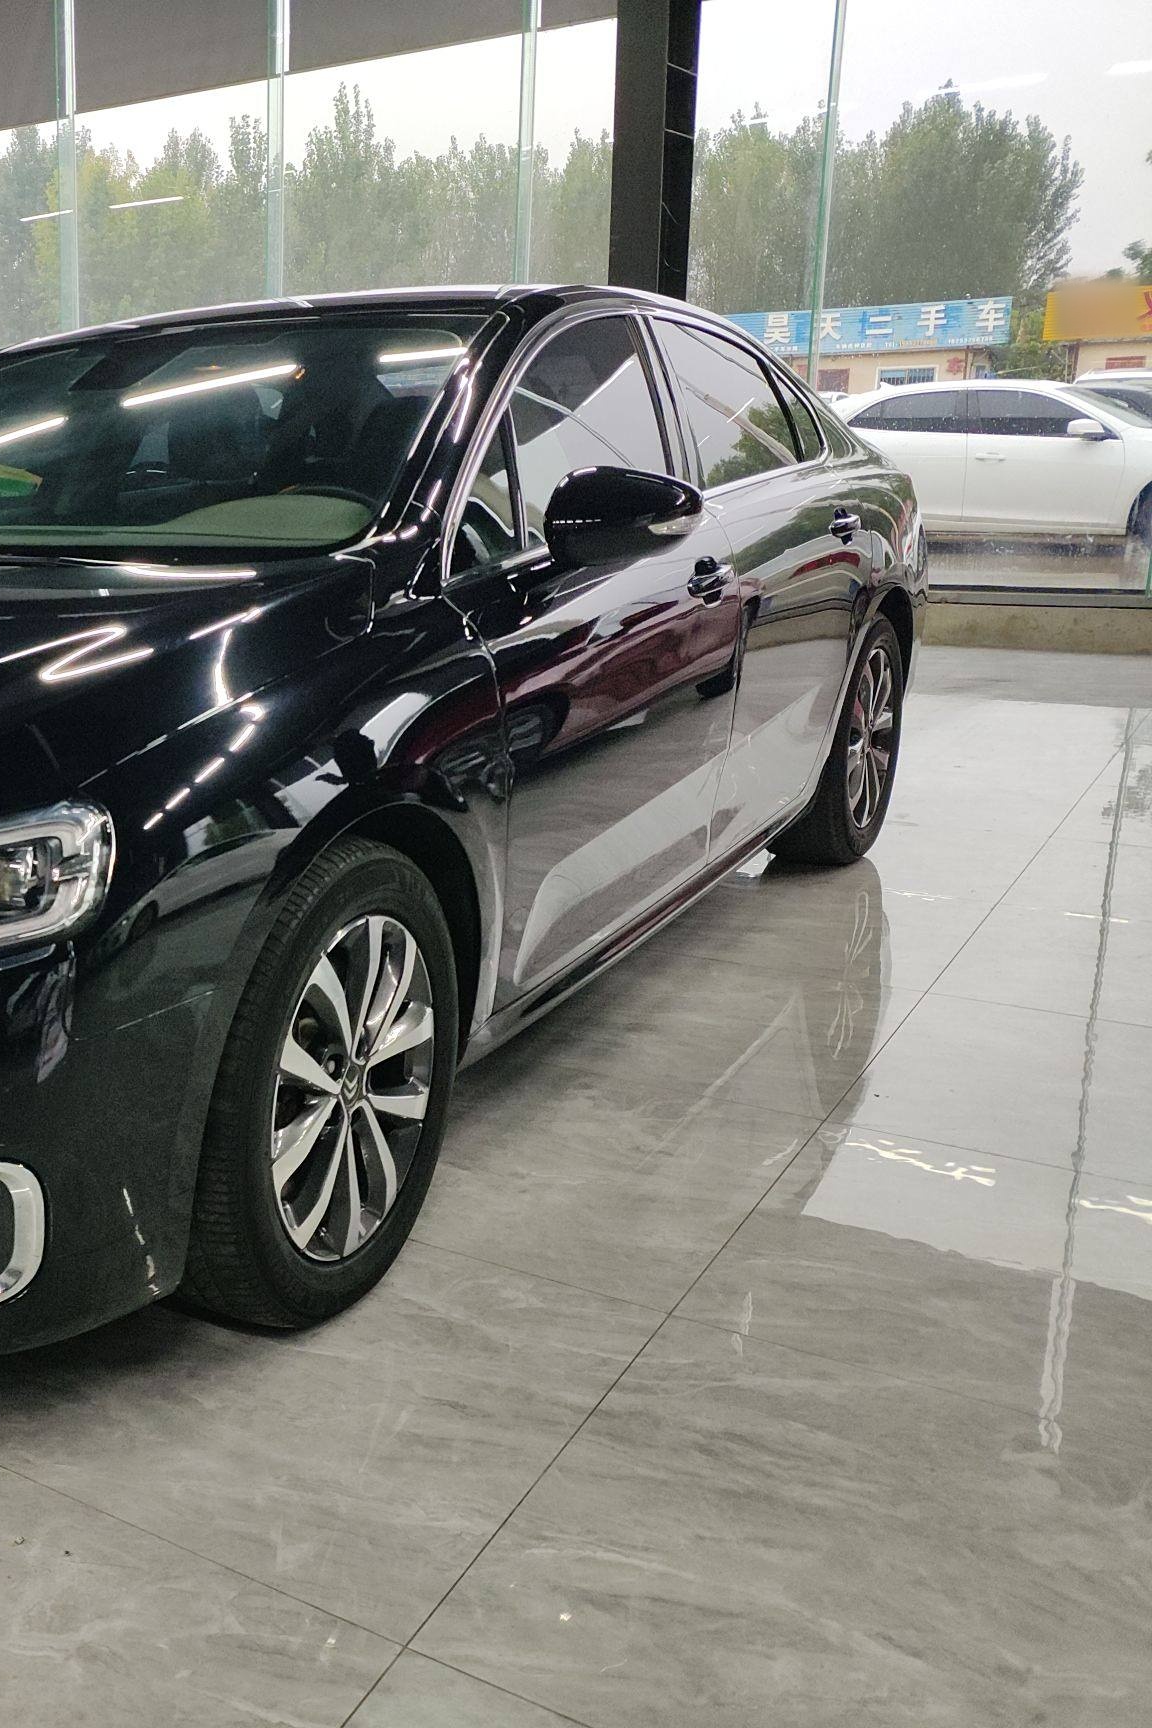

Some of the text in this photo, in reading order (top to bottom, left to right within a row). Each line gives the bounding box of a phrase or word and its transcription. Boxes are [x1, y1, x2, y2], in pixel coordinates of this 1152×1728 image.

[763, 299, 1006, 343] 昊天二手车
